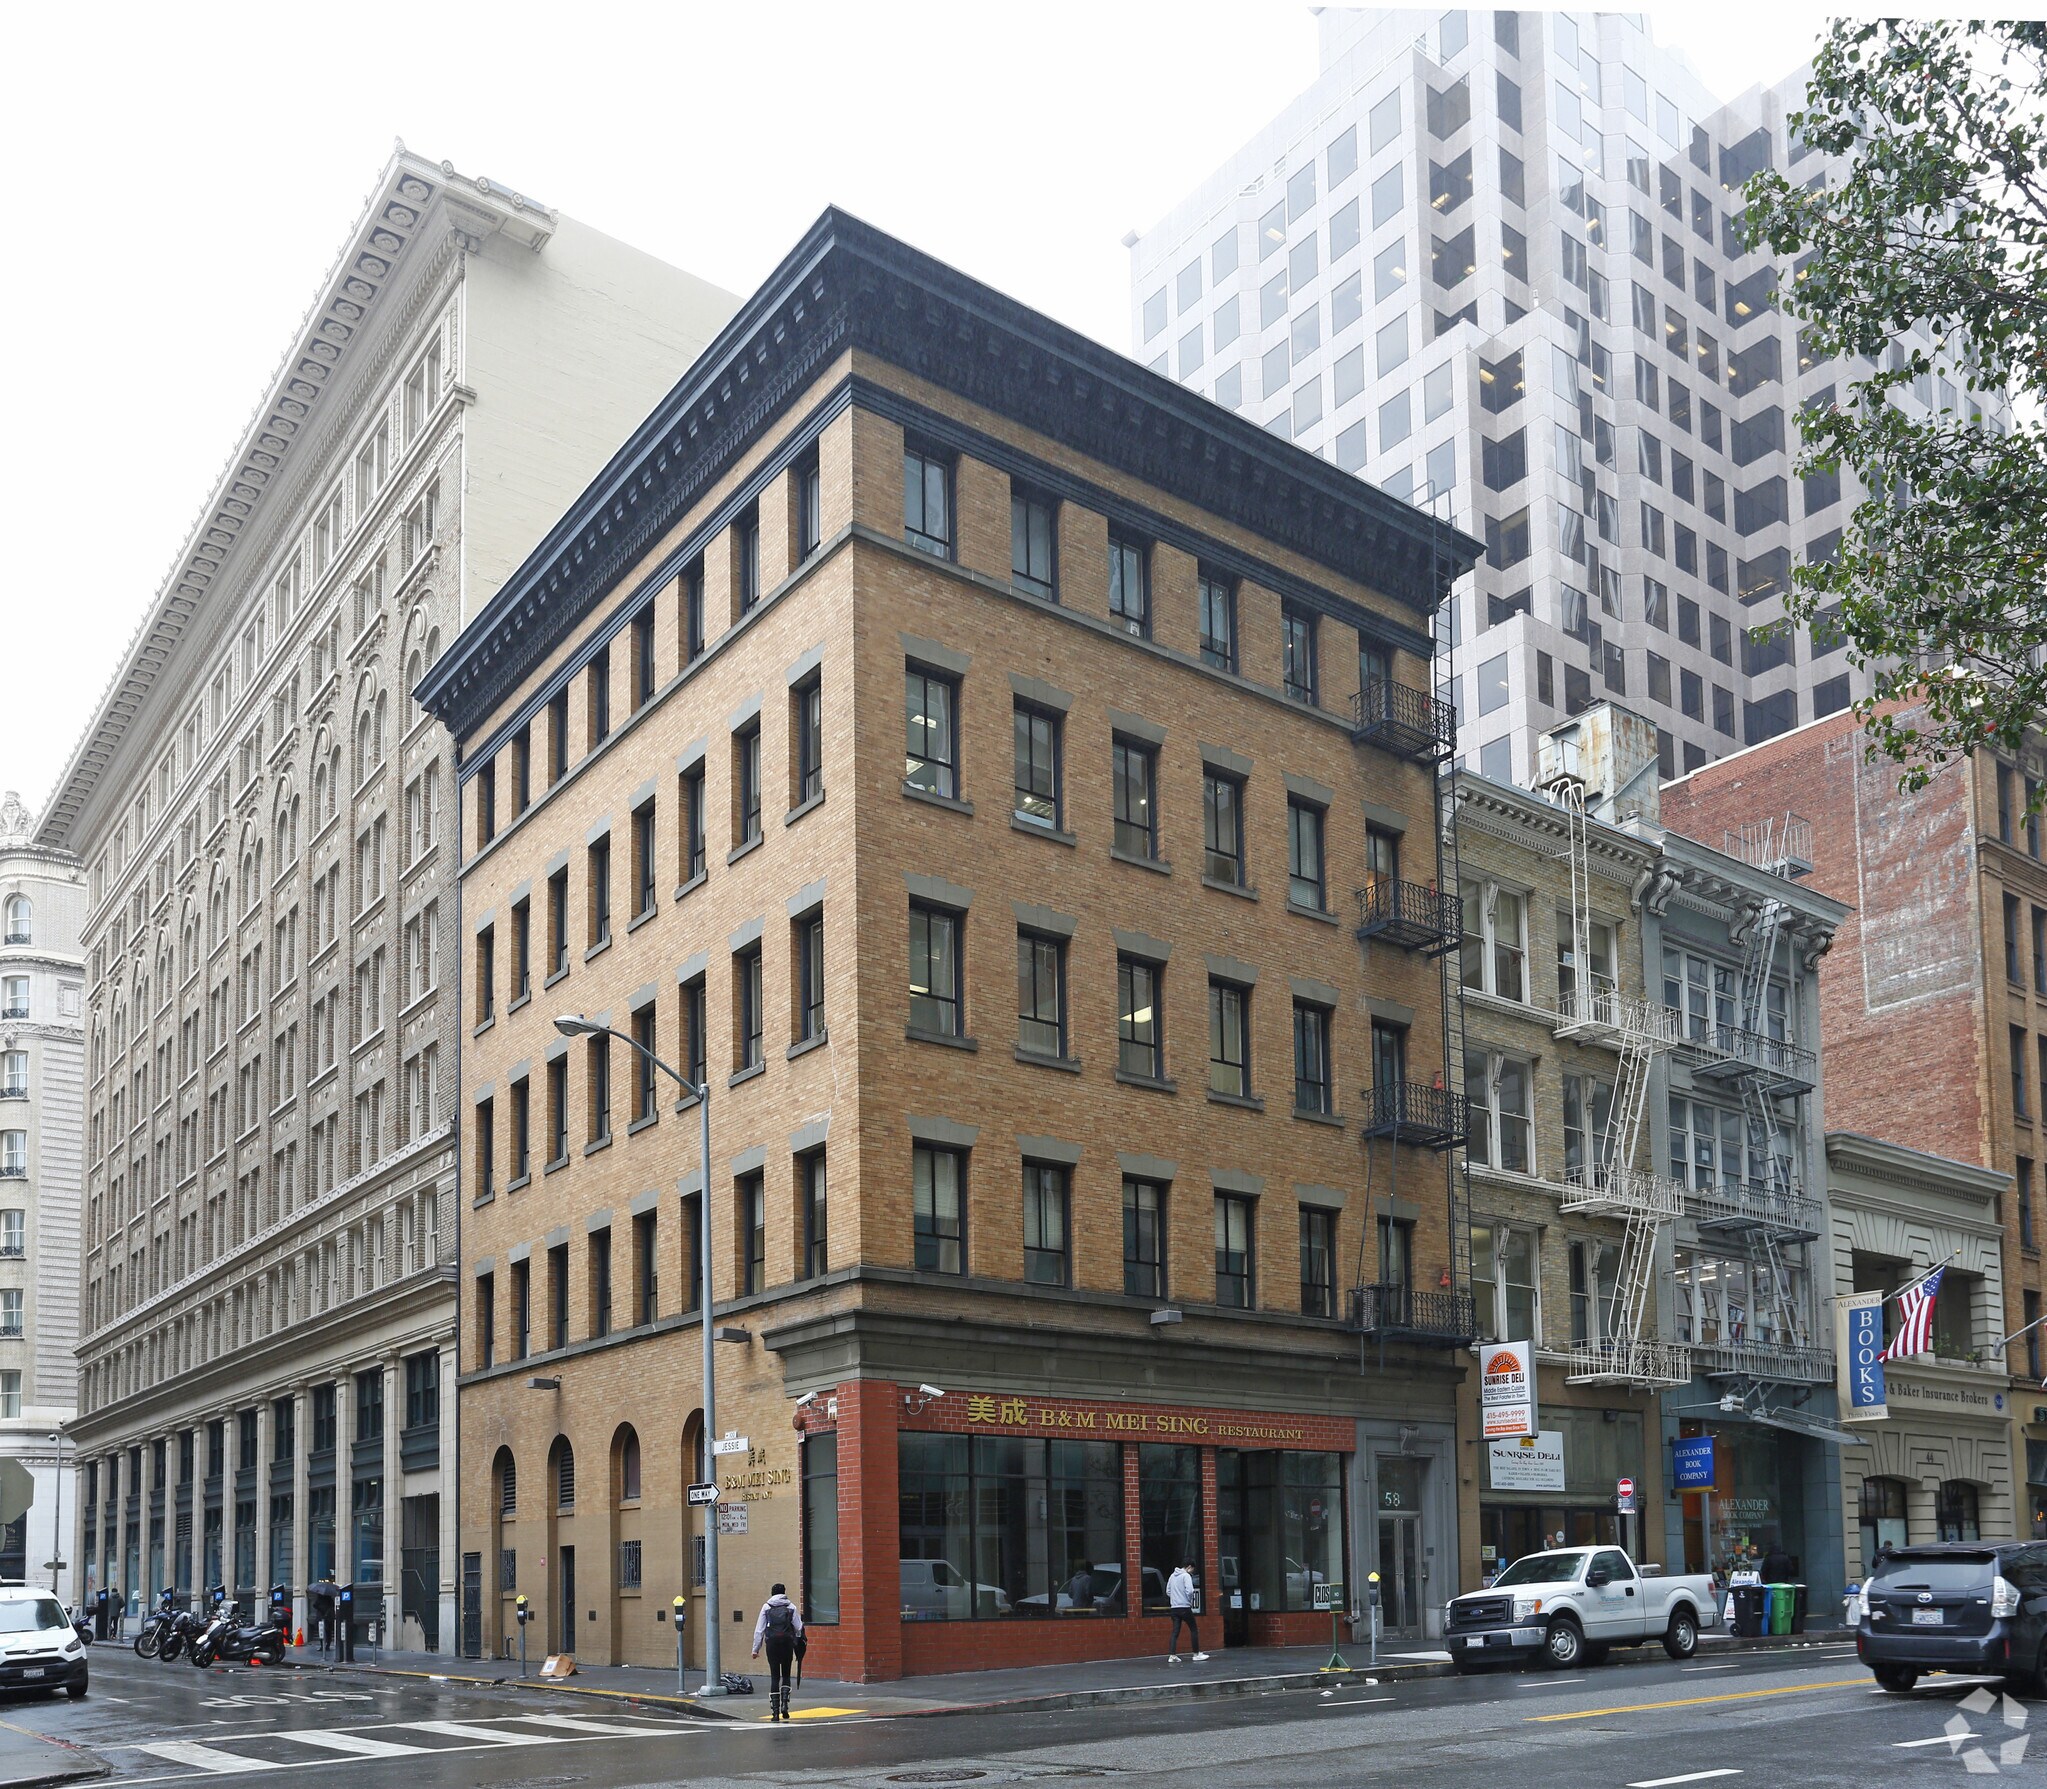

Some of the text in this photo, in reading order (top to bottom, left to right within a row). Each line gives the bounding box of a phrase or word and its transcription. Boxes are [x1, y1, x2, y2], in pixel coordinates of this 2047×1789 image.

[1838, 1297, 1881, 1309] ALEXANDER
[1858, 1310, 1875, 1403] BOOKS
[1484, 1372, 1525, 1386] SUNRISE DELI
[1898, 1384, 1919, 1398] Baker
[1922, 1386, 1959, 1402] Insurance
[1961, 1391, 1988, 1405] Brokers
[968, 1395, 1028, 1425] 美成
[1040, 1409, 1209, 1434] B&M MEI SING
[1218, 1425, 1304, 1440] RESTAURANT
[721, 1441, 740, 1451] JESSIE
[1675, 1447, 1711, 1457] ALEXANDER
[1493, 1449, 1535, 1459] SUNRISE
[1538, 1452, 1560, 1460] DELI
[1685, 1460, 1701, 1468] BOOK
[768, 1469, 791, 1485] SING
[1680, 1471, 1708, 1480] COMPANY
[691, 1491, 700, 1499] ONE
[1385, 1492, 1400, 1507] 58
[720, 1504, 728, 1512] NO
[1720, 1498, 1769, 1511] ALEXANDER
[1723, 1511, 1765, 1520] BOOK COMPANY
